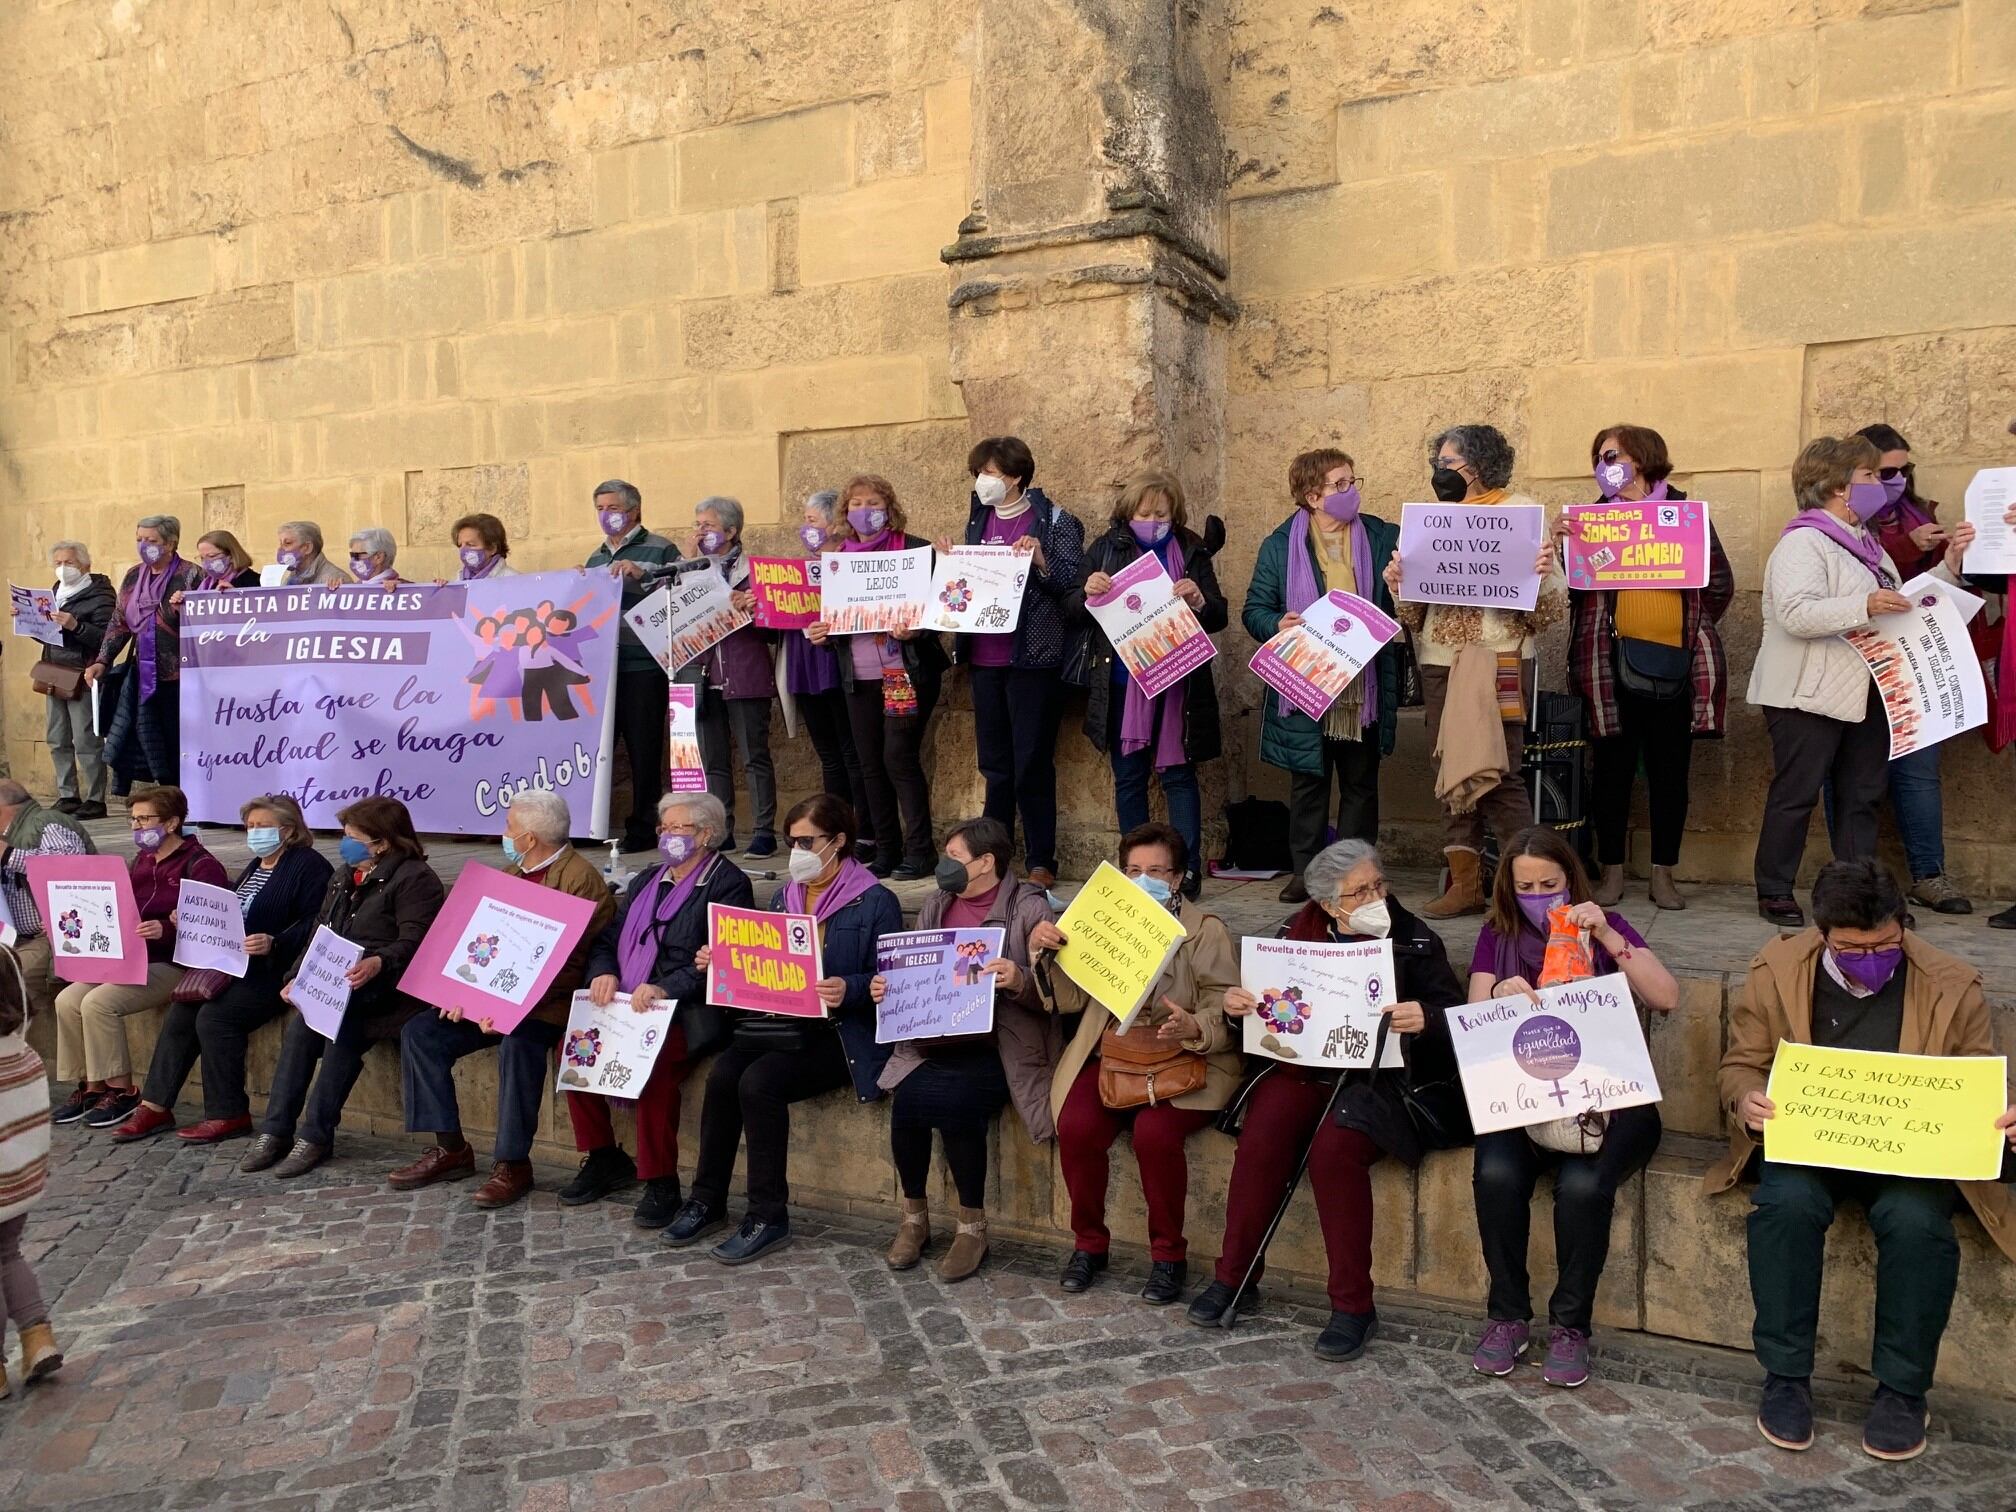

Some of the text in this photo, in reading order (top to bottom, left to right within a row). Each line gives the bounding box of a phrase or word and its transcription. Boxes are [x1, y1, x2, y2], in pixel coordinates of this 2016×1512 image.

[1424, 515, 1513, 532] CON VOTO,
[1579, 510, 1642, 522] NOSOTRAS
[1580, 523, 1655, 543] SOMOS EL
[1432, 539, 1501, 553] CON VOZ
[1621, 542, 1683, 566] CAMBIO
[754, 561, 803, 585] DIGNIDAD
[850, 557, 915, 574] VENIMOS DE
[1436, 562, 1500, 576] ASI NOS
[680, 583, 712, 607] MUCH
[866, 576, 899, 590] LEJOS
[1420, 582, 1519, 598] QUIERE DIOS
[185, 593, 422, 616] REVUELTA DE MUJERES
[766, 585, 772, 602] E
[773, 590, 821, 615] IGUALDA
[980, 604, 1010, 620] ALCEMOS
[1144, 614, 1154, 624] CON
[1154, 606, 1164, 616] VOZ
[1168, 595, 1181, 606] VOTO
[975, 616, 1007, 628] LA VOZ
[198, 618, 403, 660] en la IGLESIA
[1324, 638, 1336, 649] CON
[1335, 646, 1346, 656] VOZ
[1348, 656, 1363, 669] VOTO
[1920, 634, 1952, 720] UNA IGLESIA NUEVA
[1922, 612, 1964, 730] IMAGINAMOS Y CONSTRUIMOS
[215, 674, 442, 726] Hasta que la
[198, 716, 504, 781] igualdad se haga
[475, 742, 600, 816] Córdob
[184, 894, 208, 908] HASTA
[221, 902, 228, 912] LA
[1097, 885, 1114, 898] SI
[1114, 898, 1140, 918] LAS
[180, 912, 220, 928] IGUALDAD
[717, 912, 782, 950] DIGNIDAD
[906, 937, 914, 946] DE
[916, 934, 944, 944] MUJERES
[1093, 910, 1152, 960] CALLAMOS
[326, 952, 346, 968] QUE
[906, 952, 938, 966] IGLESIA
[1072, 920, 1150, 987] GRITARAN LA
[1256, 943, 1294, 955] Revuelta
[1296, 946, 1308, 956] de
[1310, 949, 1345, 958] mujeres
[1356, 948, 1362, 956] la
[1363, 946, 1382, 958] Iglesia
[731, 947, 808, 992] E IGUALDAD
[1080, 951, 1130, 995] PIEDRAS
[332, 976, 346, 990] SE
[886, 968, 947, 998] Hasta que la
[880, 986, 961, 1024] igualdad se haga
[1457, 1003, 1518, 1032] Revuelta
[1530, 998, 1550, 1012] de
[896, 1010, 944, 1034] costumbre
[1326, 1025, 1369, 1047] ALCEMOS
[1518, 1031, 1576, 1060] igualdad
[1322, 1041, 1366, 1060] LA VOZ
[610, 1072, 628, 1090] VOZ
[1790, 1062, 1964, 1092] SI LAS MUJERES
[1489, 1078, 1644, 1114] en la Iglesia
[1802, 1084, 1912, 1110] CALLAMOS
[1784, 1102, 1944, 1135] GRITARAN LAS
[1814, 1129, 1906, 1154] PIEDRAS
